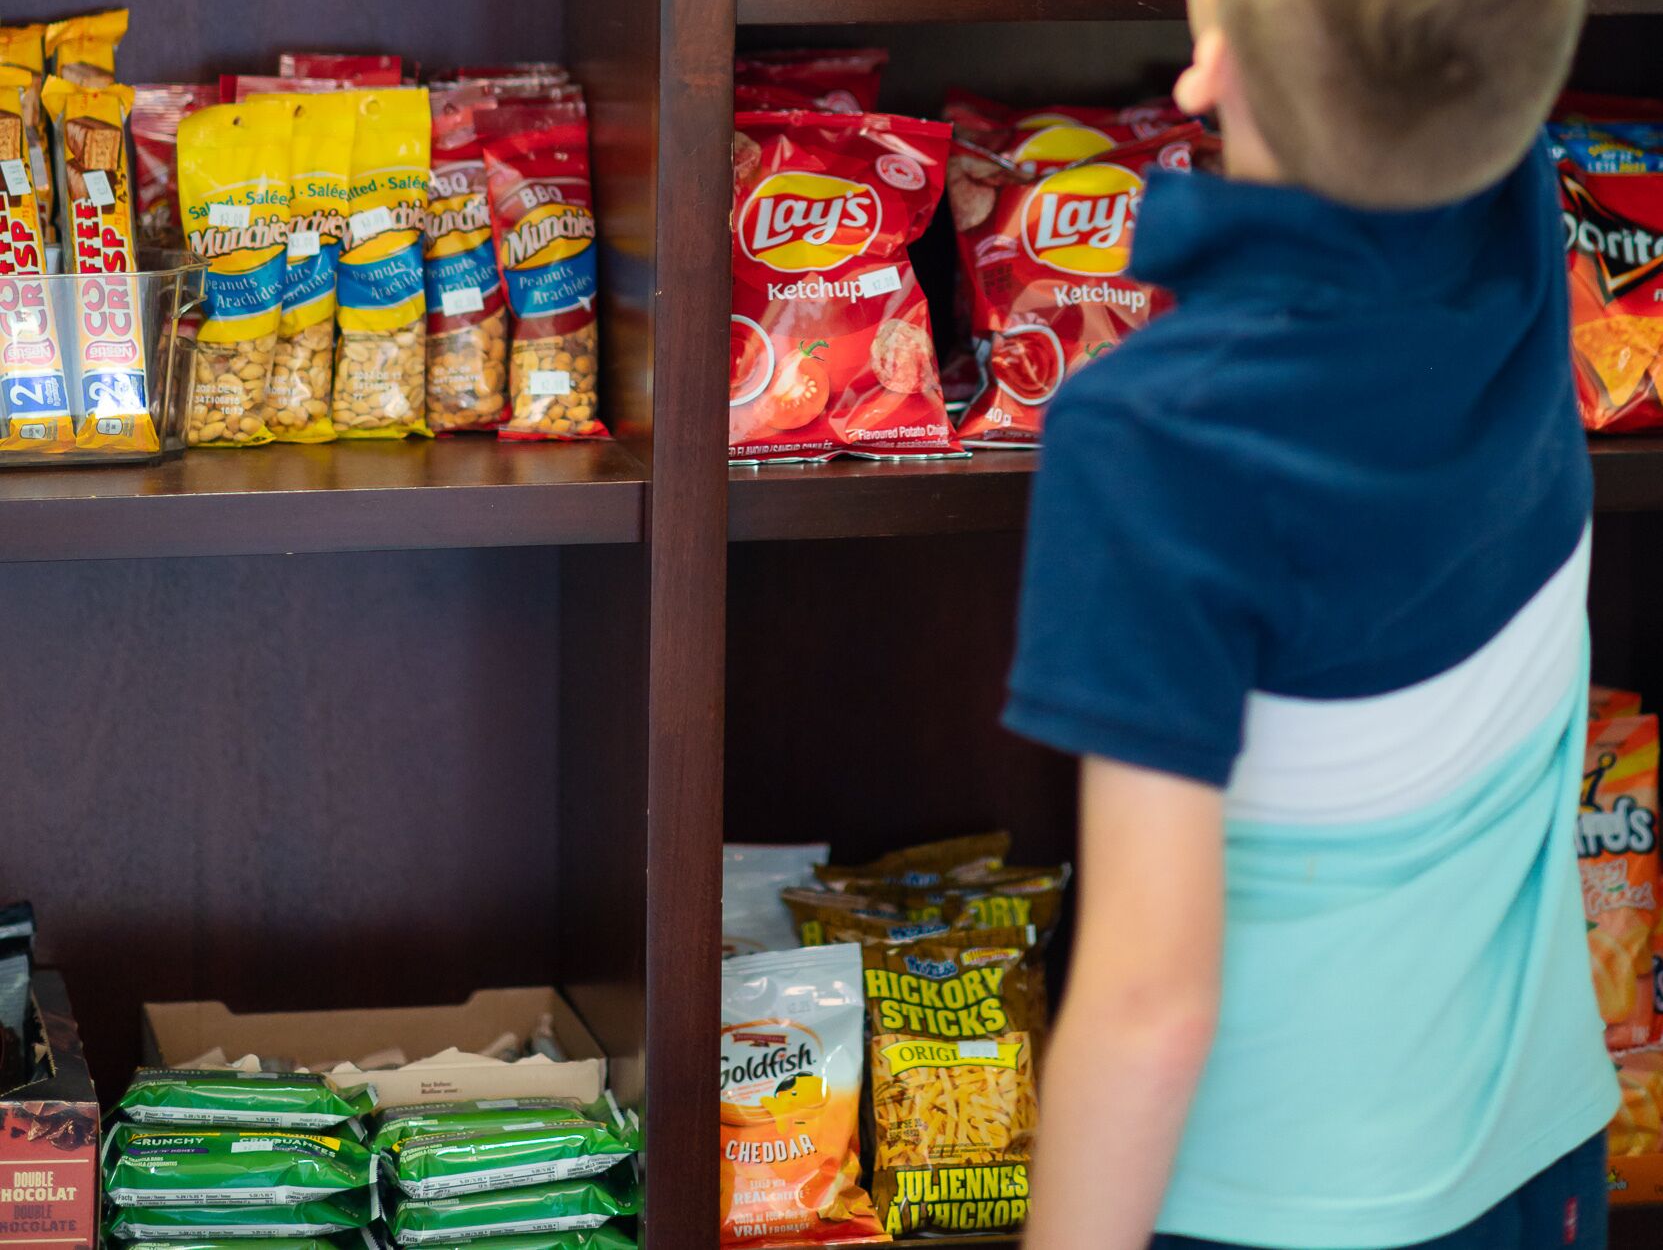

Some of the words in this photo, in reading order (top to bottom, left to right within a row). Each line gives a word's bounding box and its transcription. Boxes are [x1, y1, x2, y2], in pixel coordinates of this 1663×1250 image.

[307, 183, 346, 200] Salée
[388, 176, 428, 190] Salée
[189, 195, 234, 220] Sald
[246, 190, 287, 205] Salée
[520, 186, 563, 209] BBQ
[753, 191, 871, 249] Lay's
[190, 214, 288, 258] Munchie
[507, 210, 595, 267] Munchies
[101, 226, 132, 337] CRISP
[352, 260, 406, 282] Peanuts
[370, 267, 423, 300] Arachide
[519, 266, 574, 288] Peanuts
[206, 277, 257, 291] Peanuts
[216, 280, 283, 309] Arachides
[533, 274, 592, 305] Arachides
[768, 276, 862, 303] Ketchup
[1054, 282, 1147, 313] Ketchup
[859, 428, 898, 440] Flavoured
[900, 425, 926, 438] Potato
[927, 424, 950, 437] Chips
[865, 967, 1004, 1010] HICKORY
[880, 997, 1007, 1037] STICKS
[132, 1137, 204, 1146] CRUNCHY
[725, 1134, 817, 1164] CHEDDAR
[14, 1171, 54, 1188] DOUBLE
[894, 1165, 1029, 1203] JULIENNES
[0, 1187, 77, 1202] HOCOLAT
[734, 1191, 768, 1205] REAL
[13, 1204, 52, 1220] DOUBLE
[886, 1201, 903, 1235] À
[0, 1220, 77, 1233] HOCOLATE
[402, 1235, 418, 1243] Facts
[733, 1224, 767, 1237] VRAI
